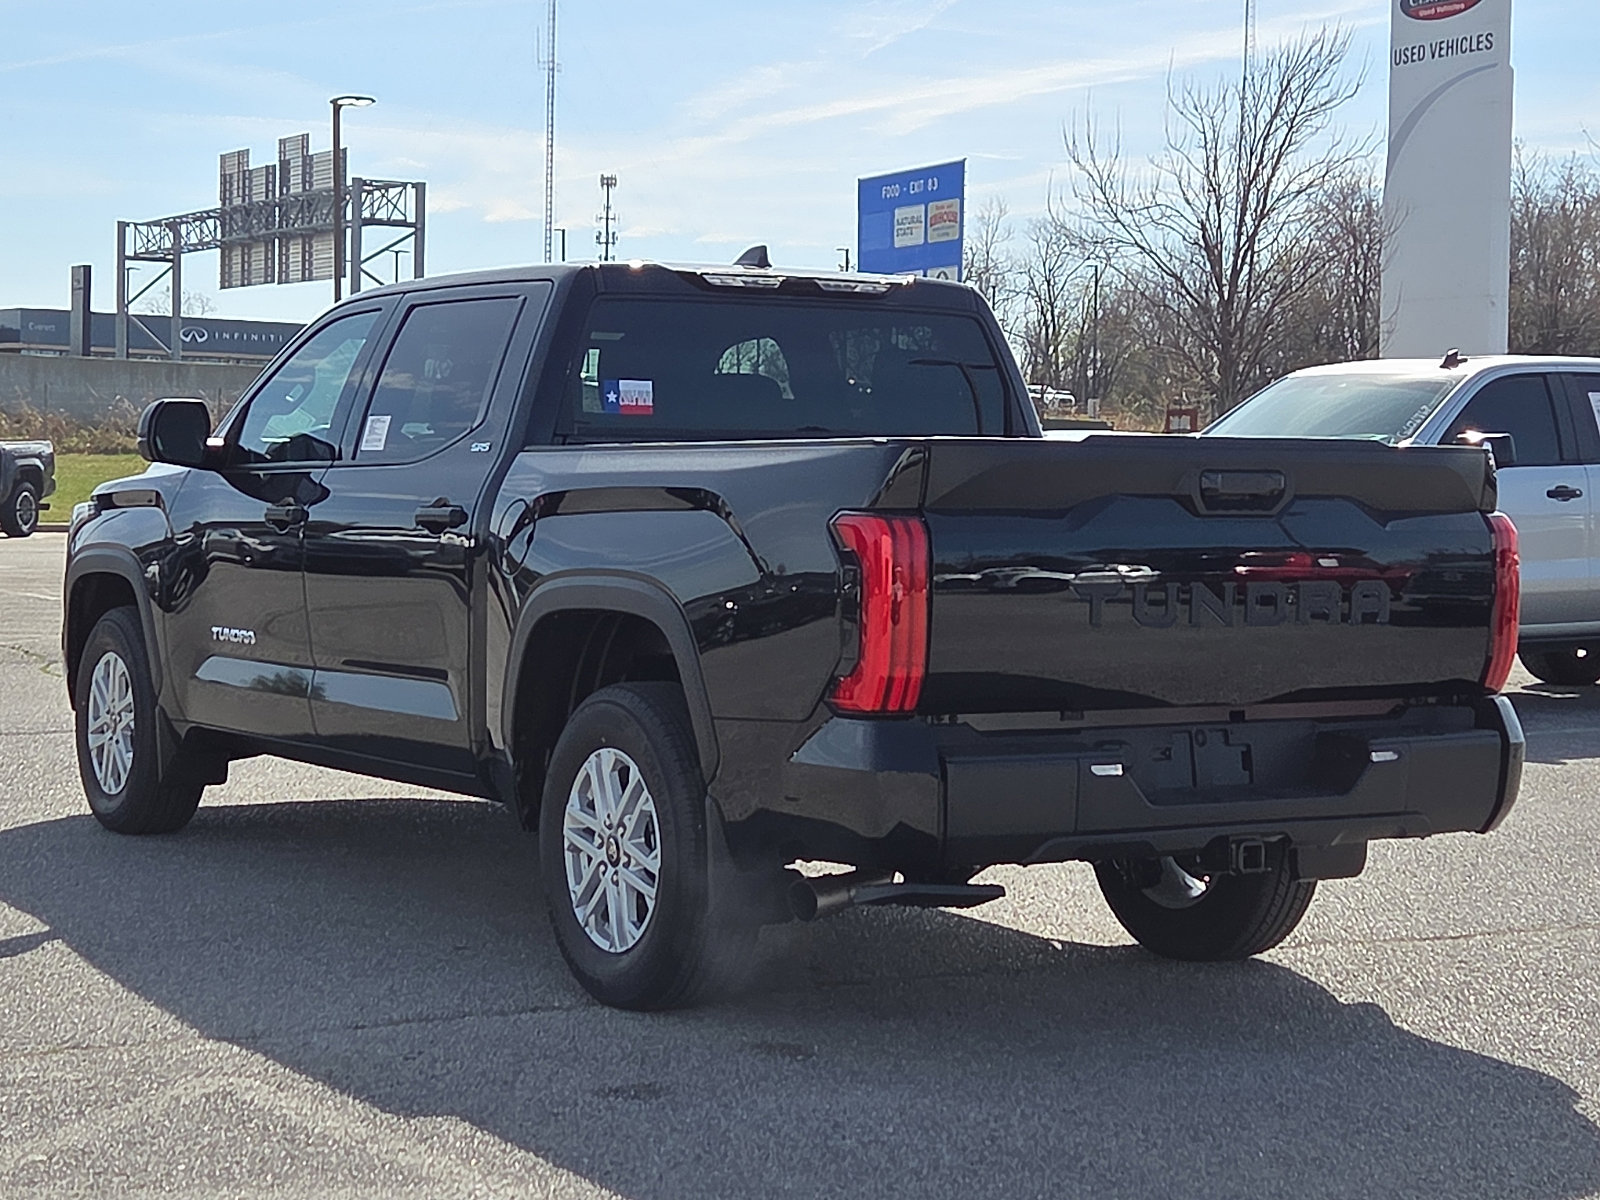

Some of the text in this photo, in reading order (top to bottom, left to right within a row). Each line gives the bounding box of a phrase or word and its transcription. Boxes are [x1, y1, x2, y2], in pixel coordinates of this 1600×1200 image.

[1394, 32, 1494, 66] USED VEHICLES
[882, 184, 900, 199] FOOD
[909, 180, 924, 194] EXIT
[927, 177, 939, 191] 83
[896, 215, 922, 226] NATURAL
[896, 227, 913, 236] STATE
[214, 331, 284, 343] INFINITI
[1069, 580, 1391, 627] TUNDRA
[211, 626, 256, 645] TUNDRA
